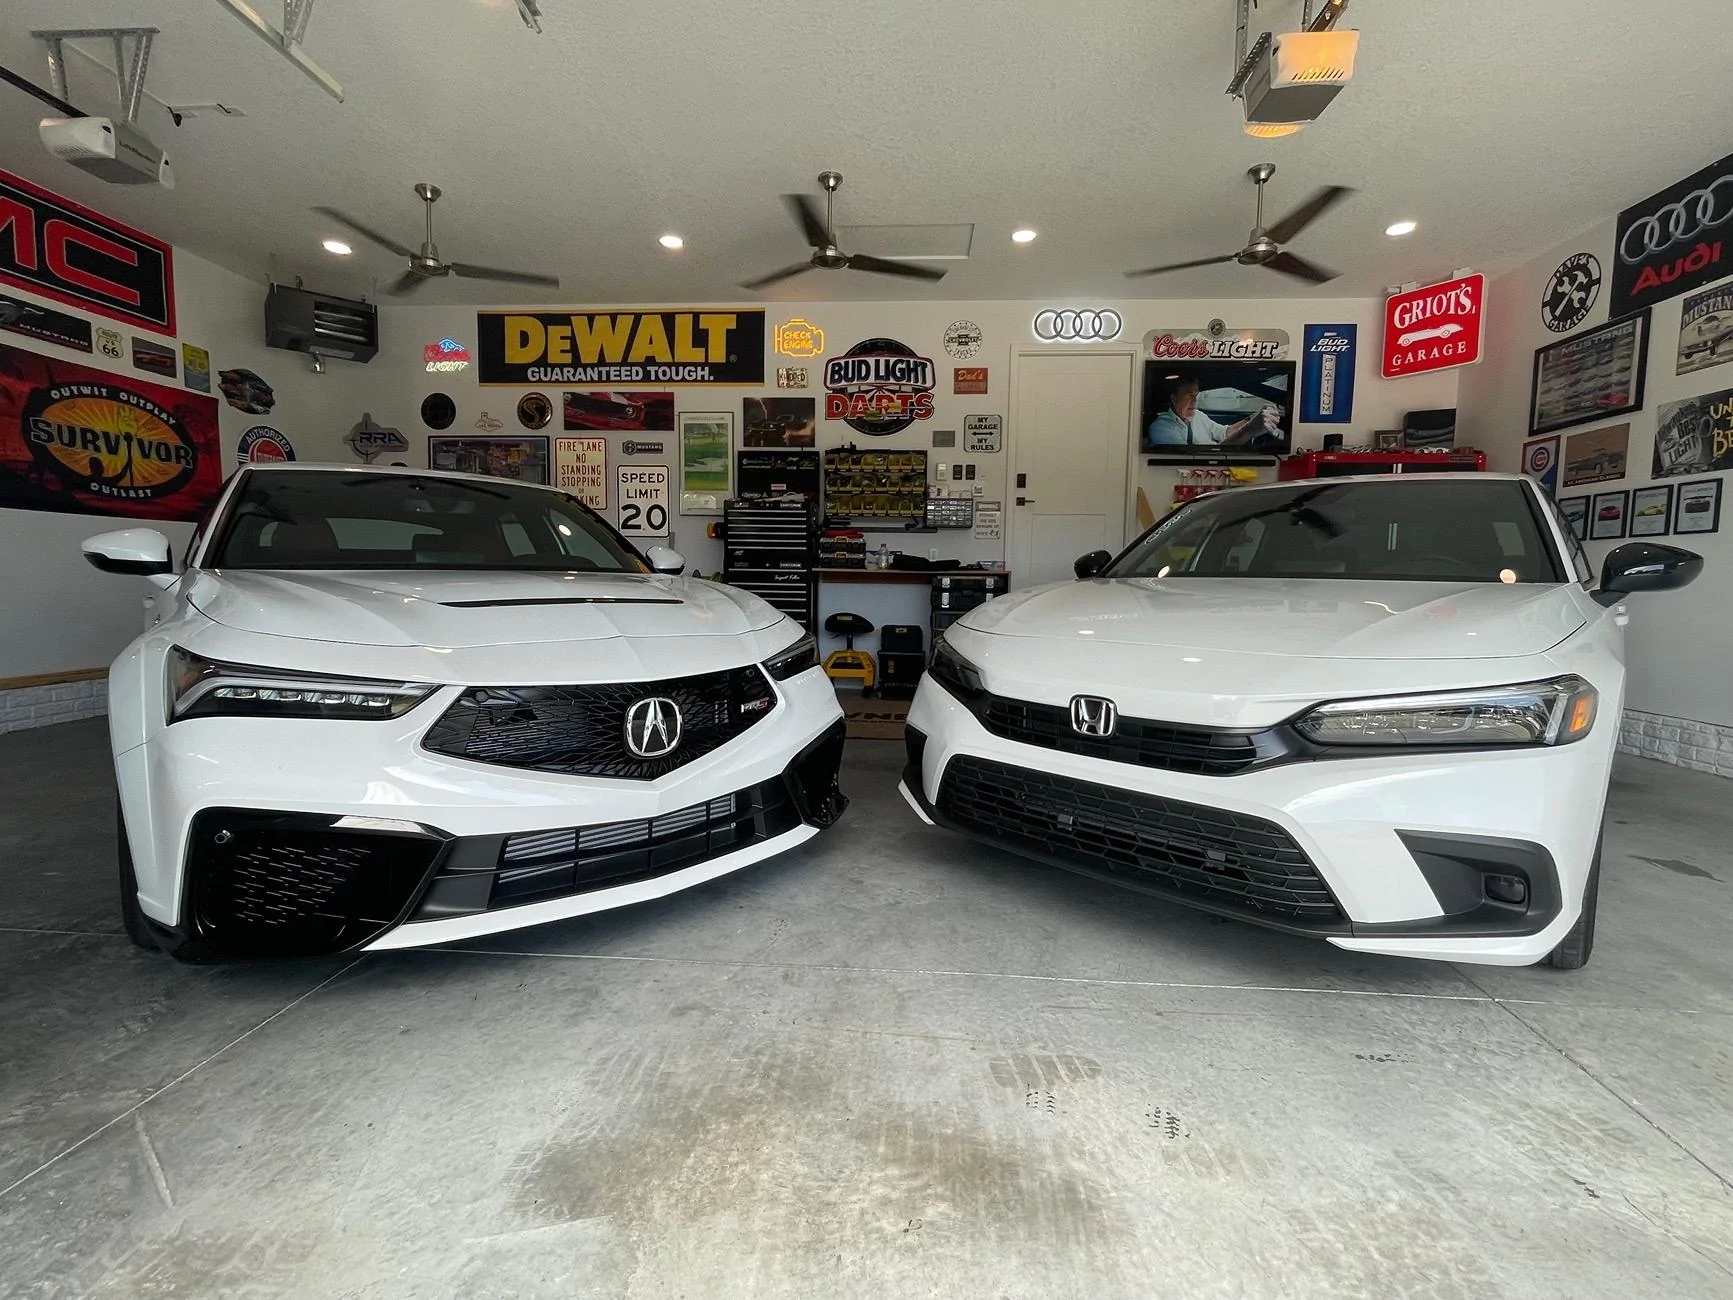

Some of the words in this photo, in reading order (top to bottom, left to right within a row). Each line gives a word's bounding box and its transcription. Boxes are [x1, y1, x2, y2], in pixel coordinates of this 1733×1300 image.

[1393, 283, 1474, 330] GRIOT'S
[1682, 295, 1733, 328] MUSTAN
[783, 330, 811, 340] CHECK
[1317, 338, 1349, 346] BUD
[1562, 326, 1633, 354] MUSTANG
[102, 343, 119, 356] 66
[783, 340, 815, 349] ENGINE
[1153, 334, 1209, 358] Coors
[1210, 340, 1278, 358] LIGHT
[1391, 341, 1467, 367] GARAGE
[426, 361, 468, 372] LIGHT
[527, 366, 644, 382] GUARANTEED
[647, 366, 714, 382] TOUGH.
[829, 358, 871, 385] BUD
[874, 358, 929, 386] LIGHT
[1321, 357, 1334, 412] PLATINUM
[51, 384, 109, 399] OUTWIT
[119, 391, 177, 426] OUTPLAY
[824, 392, 935, 420] DARTS
[30, 416, 194, 469] SURVIVOR
[245, 428, 290, 452] AUTHORIZED
[359, 432, 405, 444] RRA
[559, 442, 577, 452] FIRE
[580, 442, 602, 452] LANE
[575, 453, 587, 463] NO
[561, 465, 601, 475] STANDING
[621, 472, 665, 484] SPEED
[561, 476, 601, 487] STOPPING
[90, 482, 153, 498] OUTLAST
[626, 488, 660, 499] LIMIT
[620, 504, 668, 531] 20
